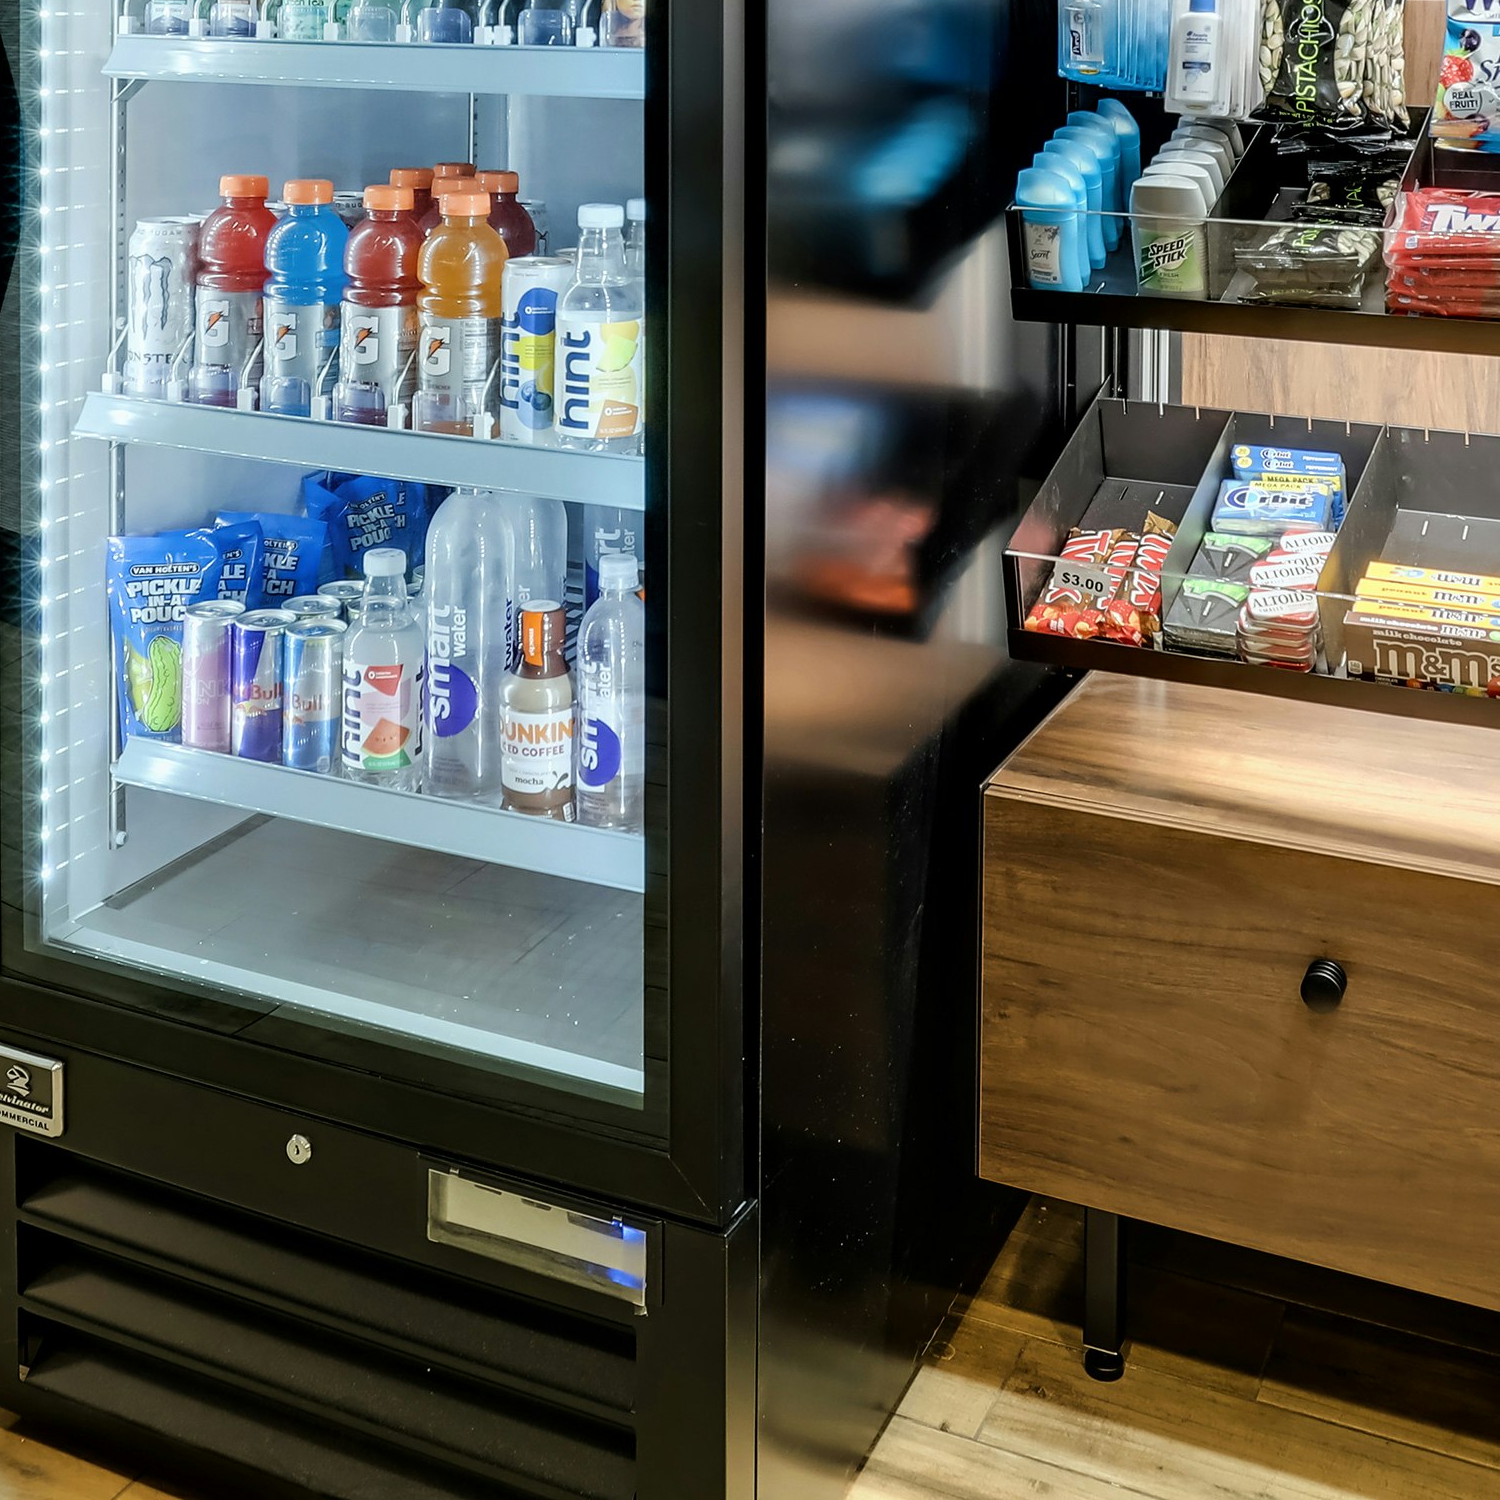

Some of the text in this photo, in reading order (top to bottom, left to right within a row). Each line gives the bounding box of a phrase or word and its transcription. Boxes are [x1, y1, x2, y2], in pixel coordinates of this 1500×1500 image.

[1452, 91, 1474, 100] REAL
[1029, 250, 1051, 262] Secret
[1149, 238, 1185, 256] SPEED
[1153, 248, 1187, 268] STICK
[200, 300, 230, 348] G
[420, 326, 451, 376] G
[559, 330, 591, 430] hint
[1262, 458, 1294, 470] Orbit
[1254, 481, 1302, 491] MEGA PACK
[1225, 486, 1315, 511] Orbit
[347, 504, 395, 528] PICKLE
[132, 566, 153, 575] VAN
[1254, 566, 1317, 582] ALTOIDS
[127, 577, 203, 598] PICKLE
[1062, 571, 1105, 594] $3.00
[1252, 591, 1317, 609] ALTOIDS
[452, 605, 467, 658] water
[1372, 628, 1463, 647] milk chocolate
[429, 604, 451, 720] smart
[250, 684, 282, 701] Bull
[521, 744, 565, 758] COFFEE
[514, 775, 544, 786] mocha
